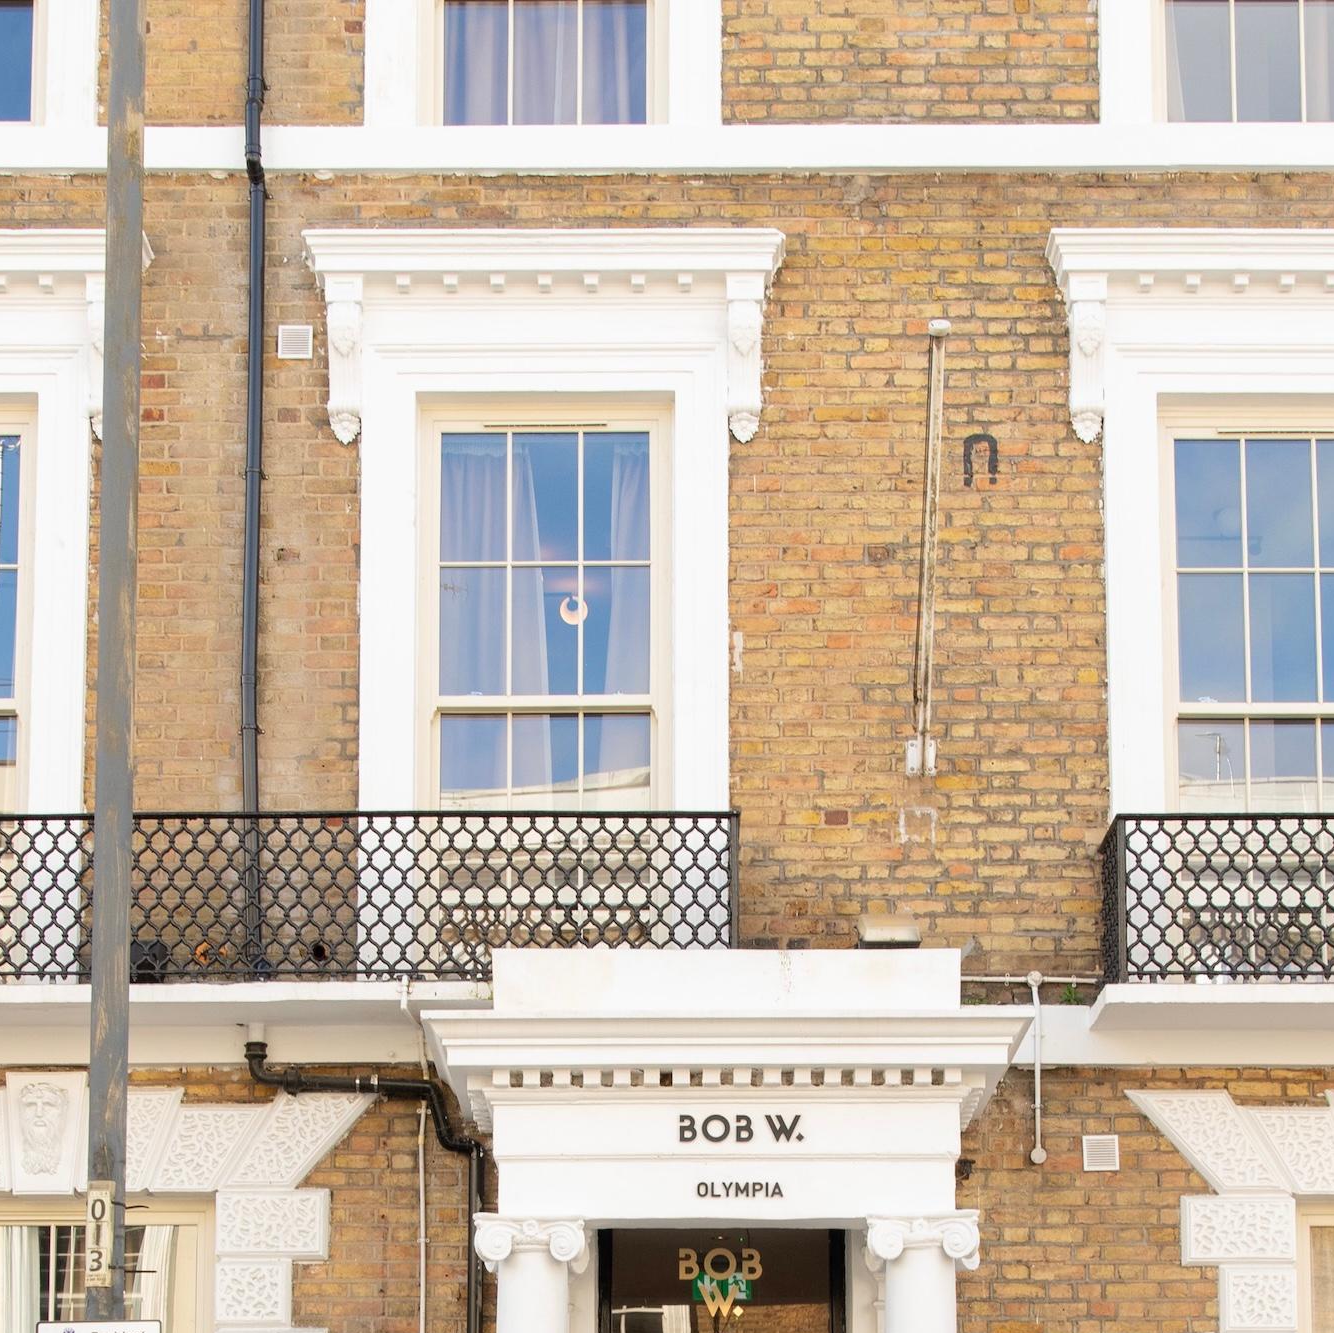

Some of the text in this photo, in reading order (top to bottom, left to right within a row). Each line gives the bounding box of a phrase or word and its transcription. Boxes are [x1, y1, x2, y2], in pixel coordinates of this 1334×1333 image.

[679, 1114, 805, 1143] BOB W.
[696, 1181, 784, 1198] OLYMPIA
[678, 1248, 763, 1281] BOB
